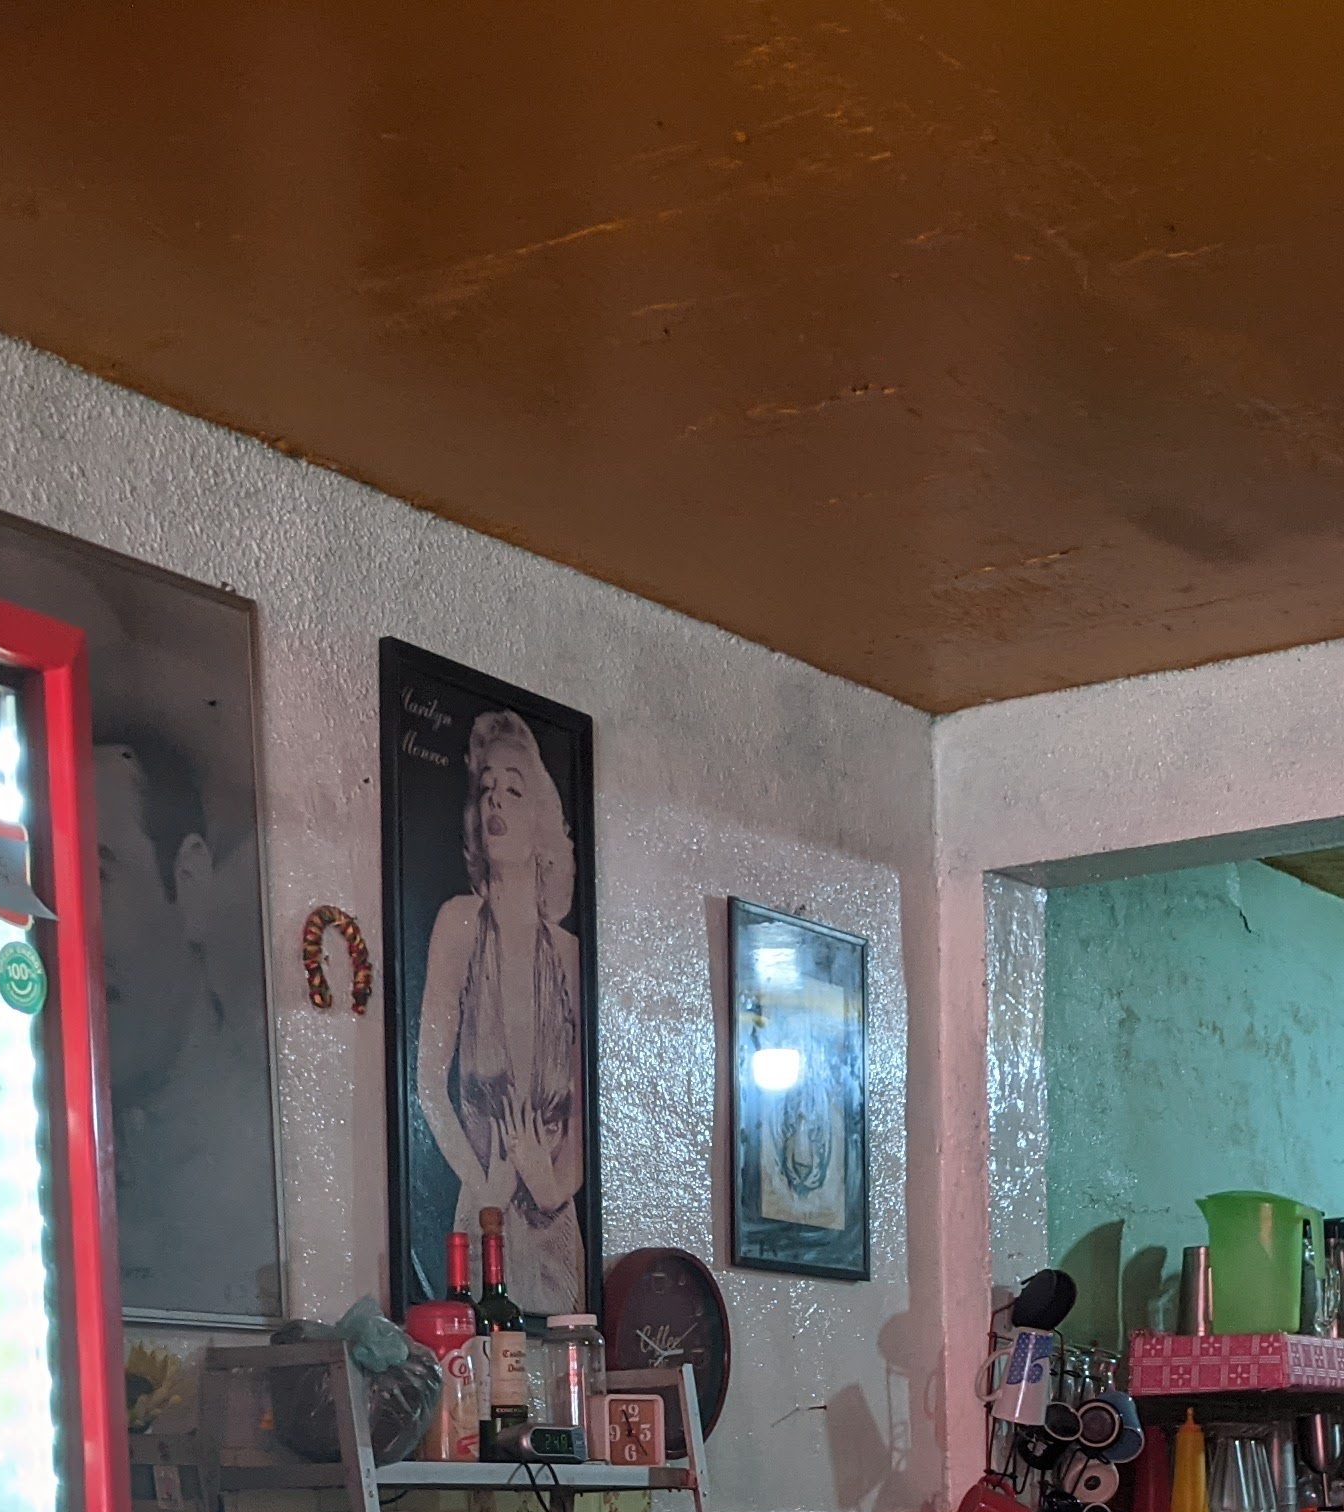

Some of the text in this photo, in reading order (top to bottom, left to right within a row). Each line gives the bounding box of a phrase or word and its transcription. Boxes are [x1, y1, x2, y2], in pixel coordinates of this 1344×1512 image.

[621, 1405, 640, 1422] 12
[610, 1425, 621, 1441] 9
[624, 1444, 637, 1461] 6
